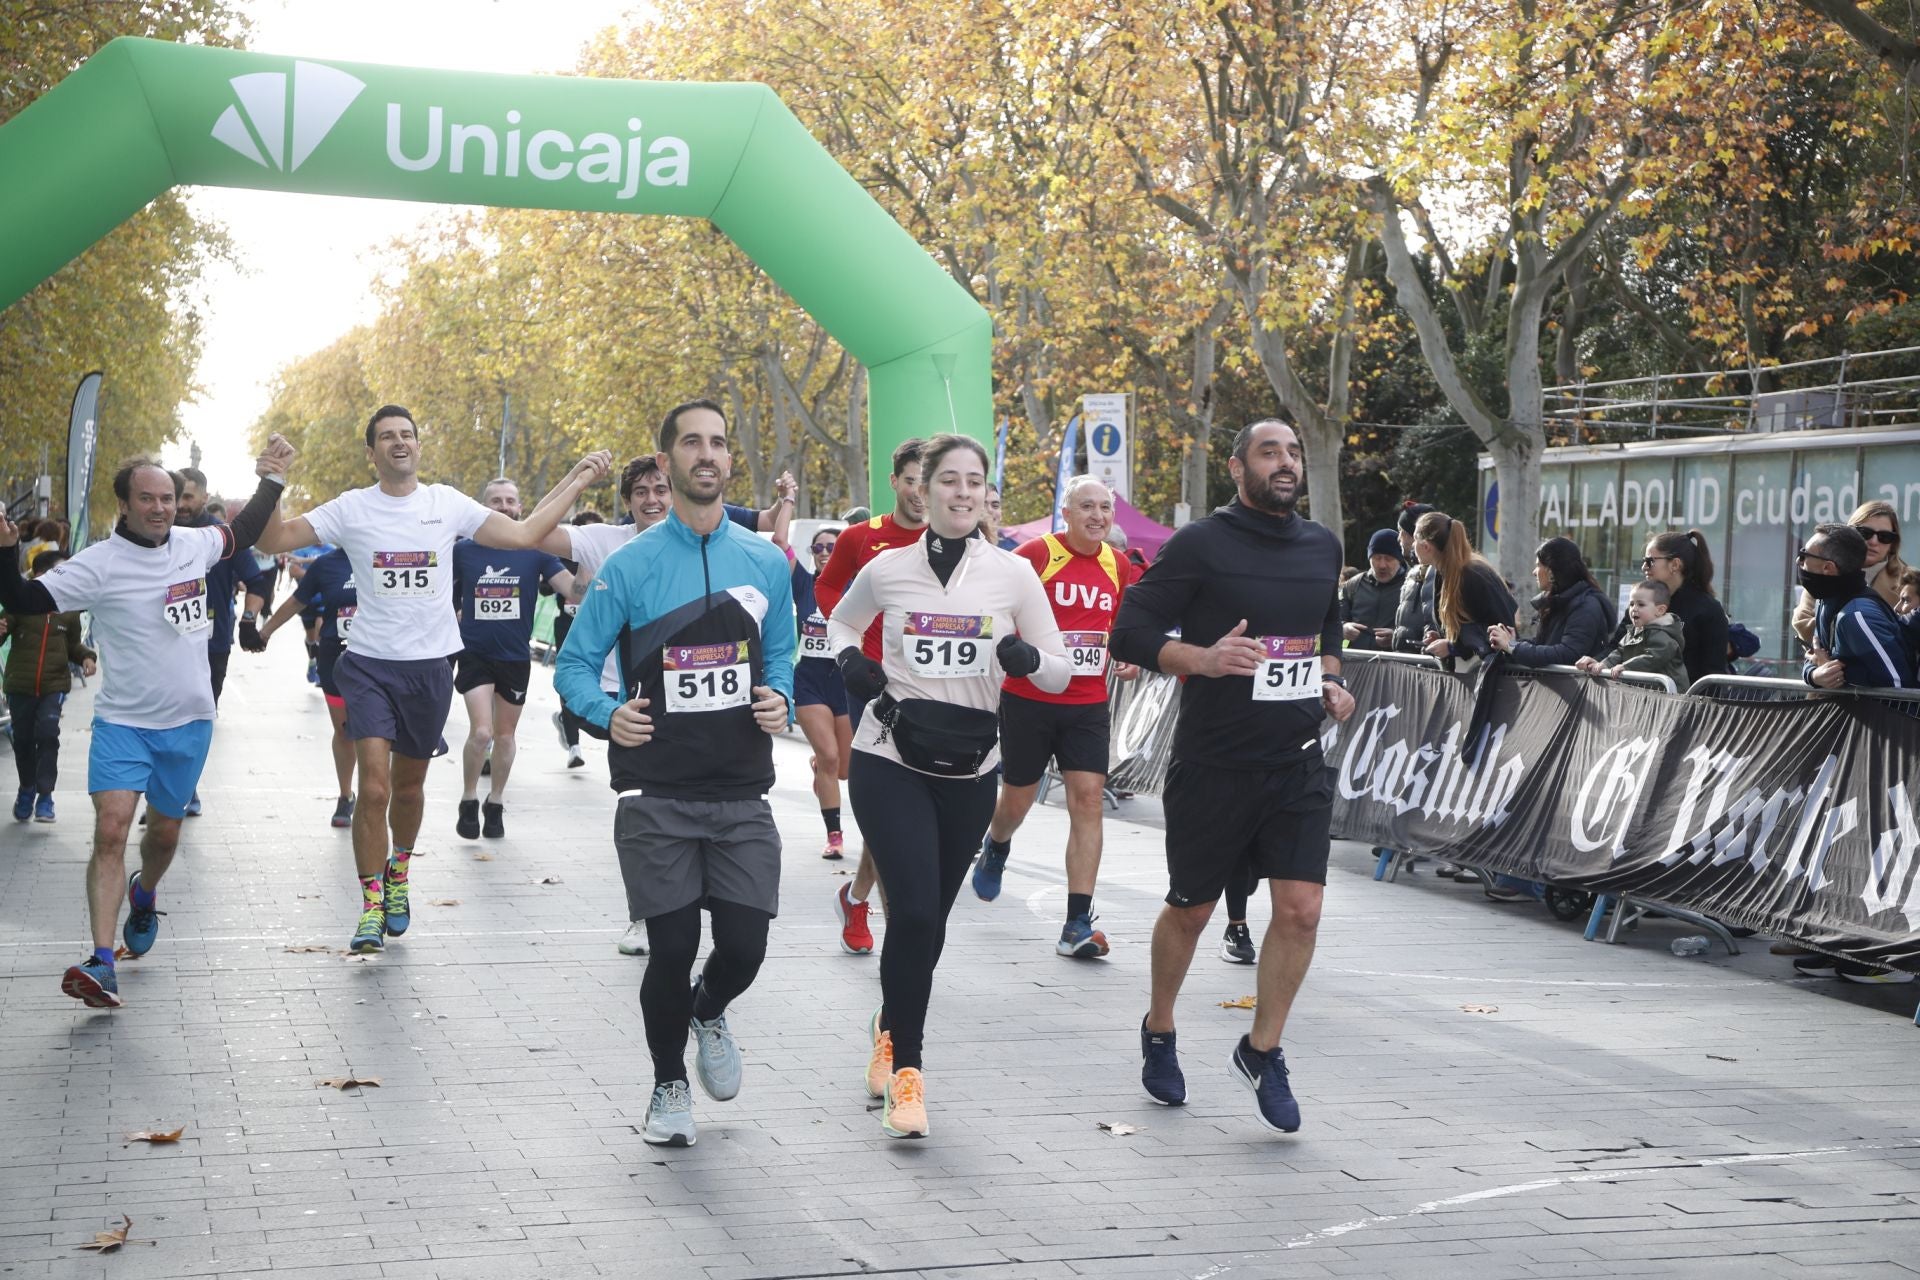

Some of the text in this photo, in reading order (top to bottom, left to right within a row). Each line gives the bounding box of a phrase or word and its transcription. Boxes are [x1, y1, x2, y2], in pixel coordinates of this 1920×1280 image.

[386, 102, 691, 199] Unicaja
[1736, 471, 1860, 525] ciudad
[382, 570, 428, 589] 315
[480, 600, 512, 613] 692
[1055, 582, 1113, 611] UVa
[168, 600, 201, 625] 313
[932, 622, 965, 630] EMPRESAS
[692, 652, 725, 661] EMPRESAS
[915, 639, 977, 667] 519
[1073, 648, 1101, 666] 949
[678, 669, 738, 698] 518
[1266, 661, 1313, 687] 517
[1571, 736, 1660, 860] El
[1658, 743, 1857, 893] Norte
